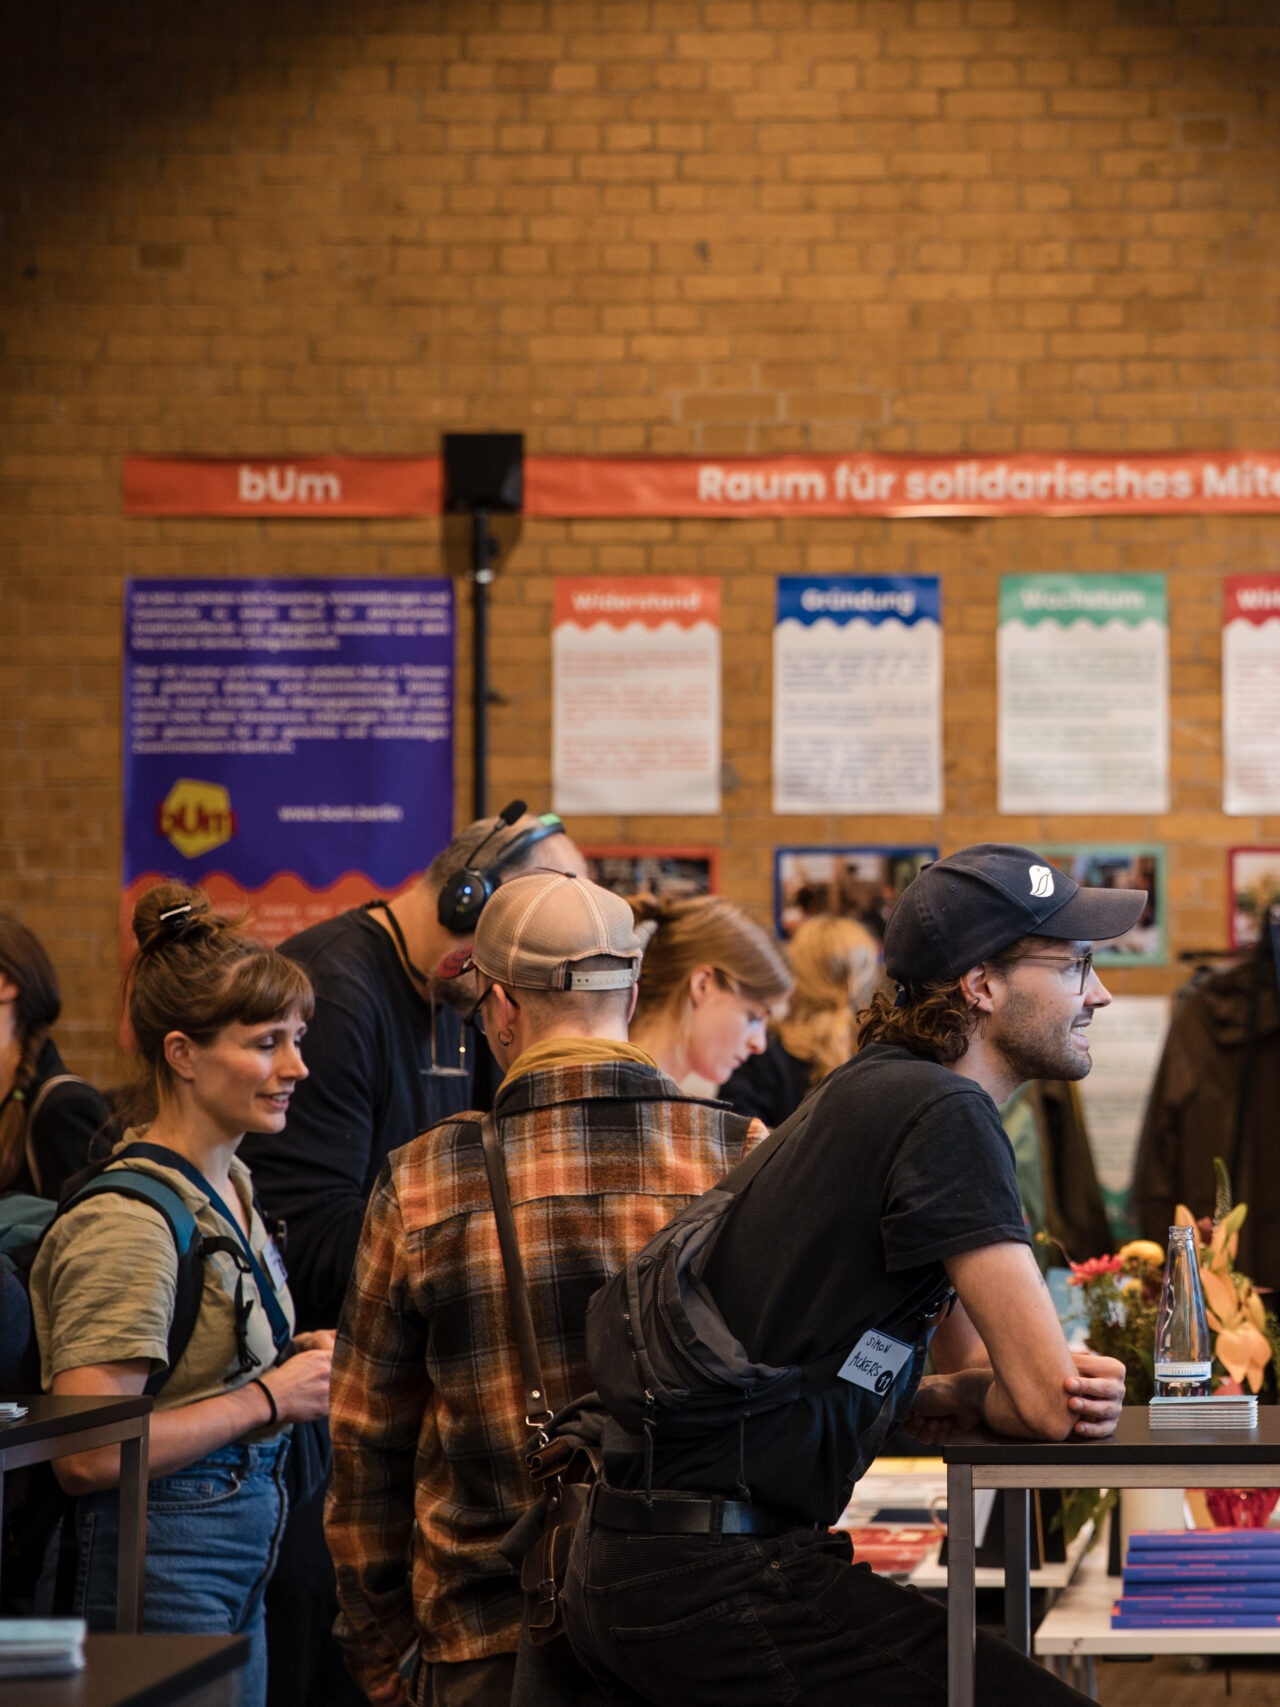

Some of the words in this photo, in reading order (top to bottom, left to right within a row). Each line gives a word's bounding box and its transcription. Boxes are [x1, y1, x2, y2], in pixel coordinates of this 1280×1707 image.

[240, 464, 340, 501] bUm
[699, 465, 826, 500] Raum
[834, 462, 896, 500] für
[904, 460, 1194, 499] solidarisches
[572, 590, 701, 611] Widerstand
[801, 588, 915, 616] Gründung
